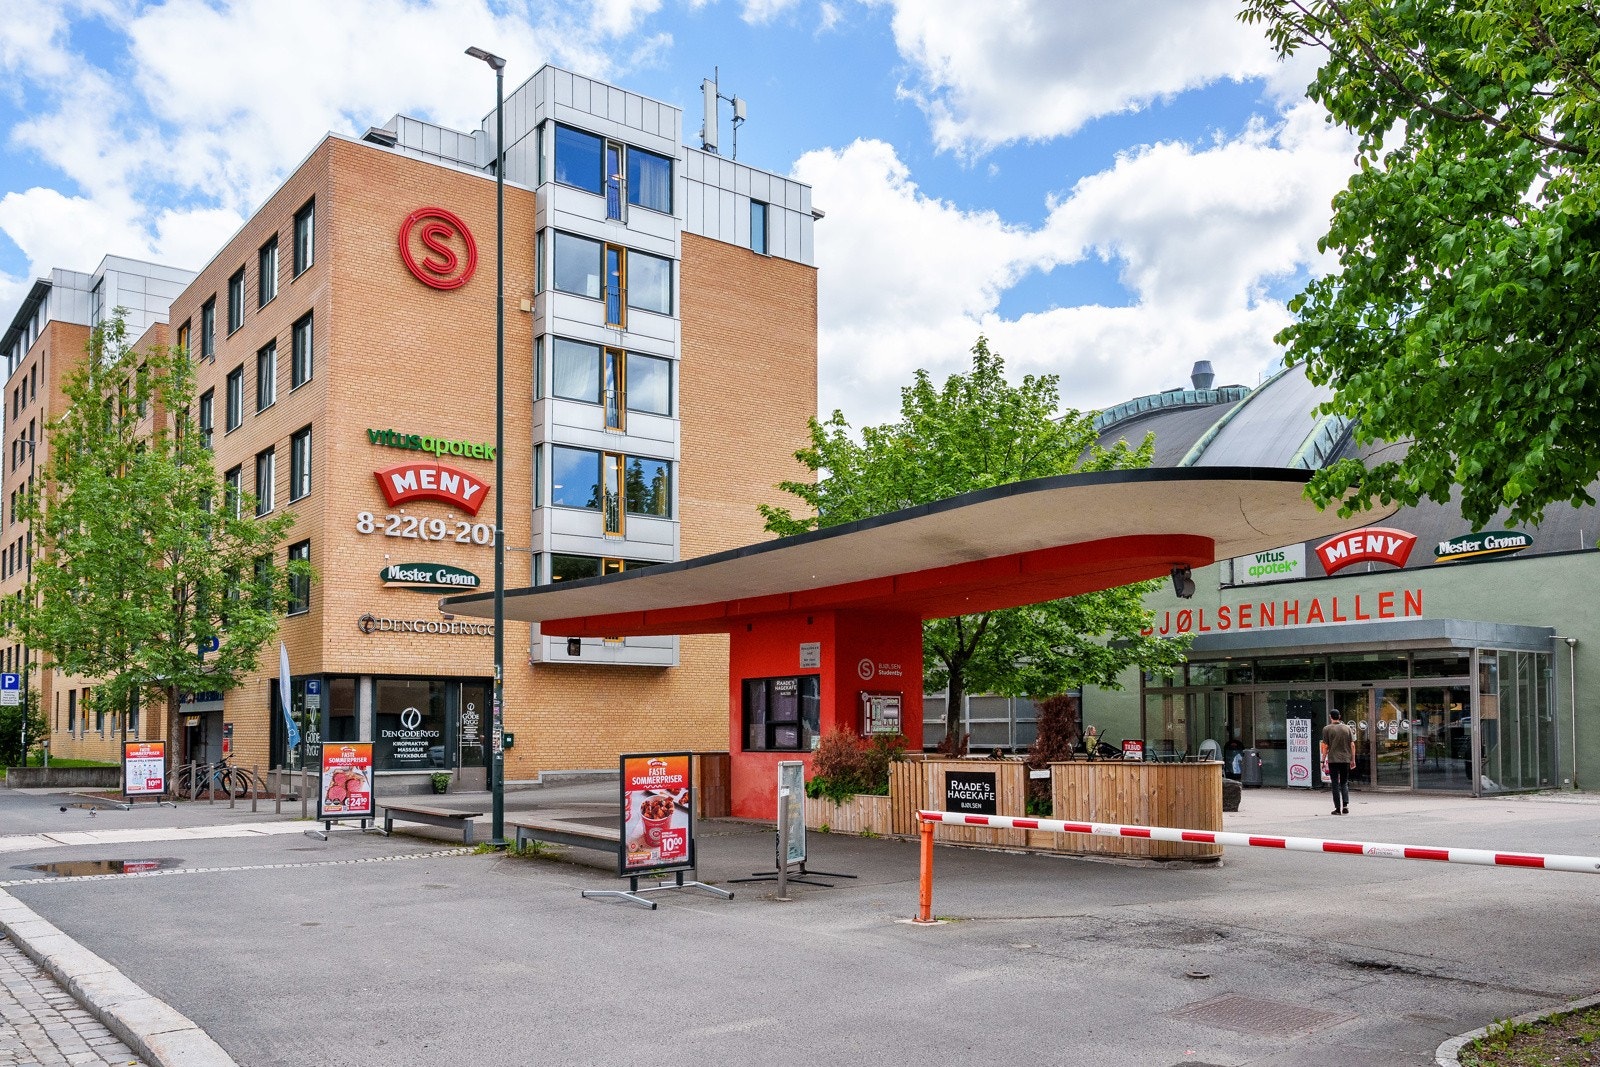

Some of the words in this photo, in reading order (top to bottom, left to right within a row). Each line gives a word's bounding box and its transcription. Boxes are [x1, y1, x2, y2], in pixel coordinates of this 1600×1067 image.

[367, 428, 496, 461] vitusapotek
[391, 469, 480, 500] MENY
[356, 511, 496, 547] 8-22(9-20)
[1325, 535, 1403, 564] MENY
[1438, 540, 1481, 554] Mester
[1484, 535, 1526, 549] Grønn
[1255, 552, 1285, 563] vitus
[388, 565, 432, 583] Mester
[436, 569, 475, 586] Grønn
[5, 675, 15, 688] P
[649, 768, 666, 776] FASTE
[632, 775, 683, 786] SOMMERPRISER
[951, 780, 990, 792] RAADE'S
[947, 790, 995, 801] HAGEKAFE
[960, 801, 982, 809] BJØLSEN
